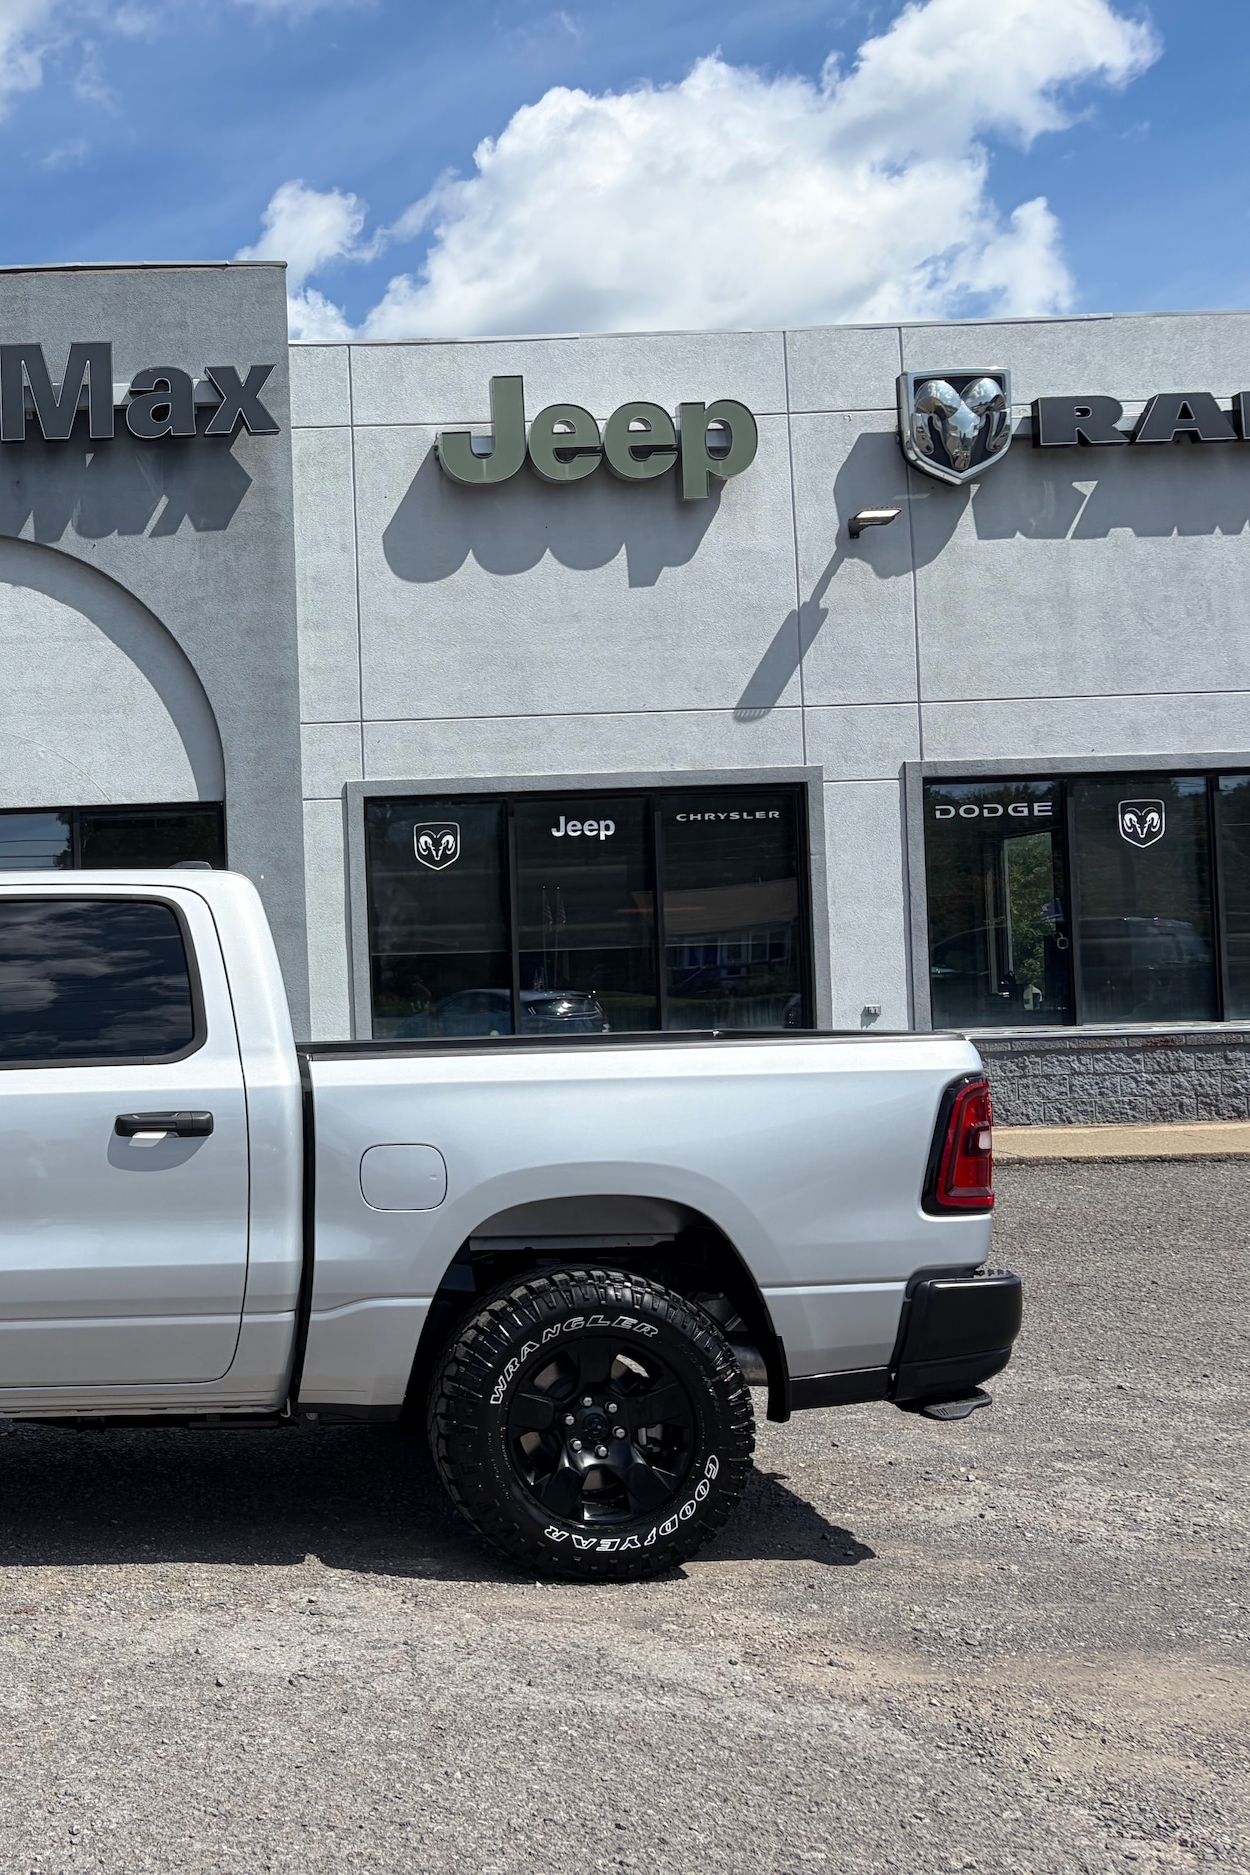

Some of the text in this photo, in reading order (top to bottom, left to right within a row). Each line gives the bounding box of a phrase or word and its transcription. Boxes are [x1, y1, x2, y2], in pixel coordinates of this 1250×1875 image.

[0, 341, 280, 444] Max
[1031, 391, 1250, 449] RA
[438, 375, 758, 498] Jeep
[551, 816, 616, 840] Jeep
[676, 811, 781, 822] CHRYSLER
[935, 802, 1053, 819] DODGE
[490, 1314, 659, 1404] WRANGLER
[544, 1455, 719, 1551] GOODYEAR
